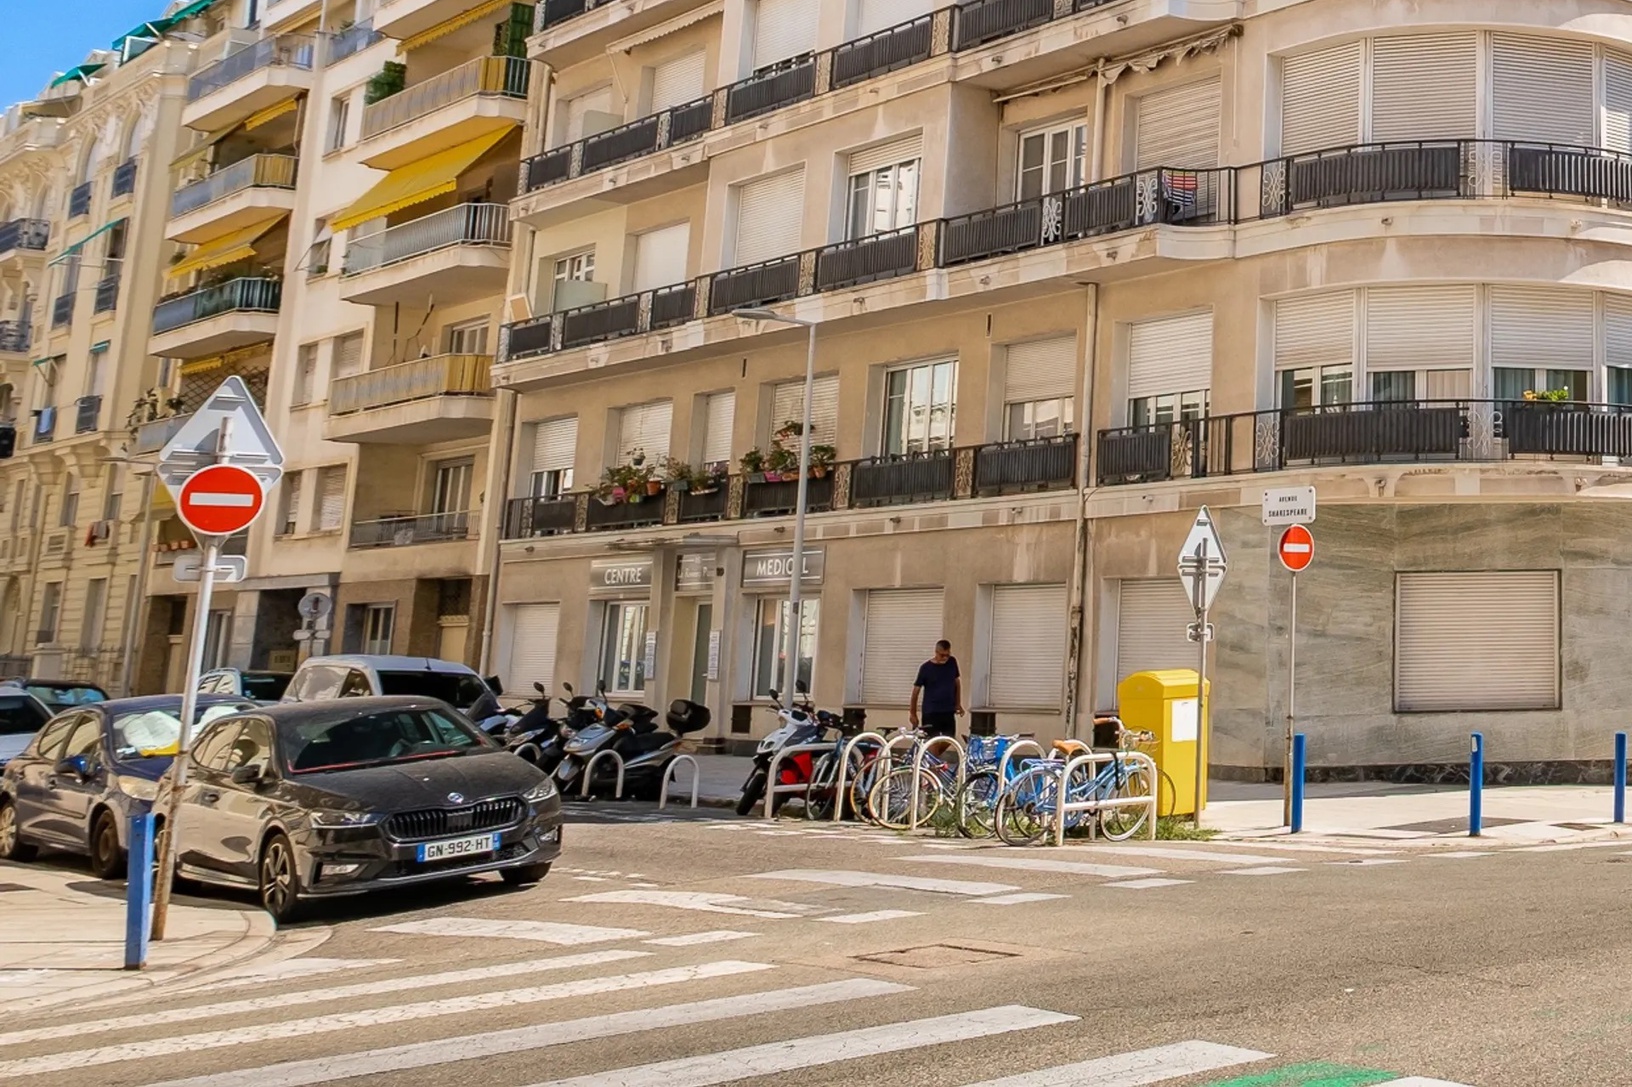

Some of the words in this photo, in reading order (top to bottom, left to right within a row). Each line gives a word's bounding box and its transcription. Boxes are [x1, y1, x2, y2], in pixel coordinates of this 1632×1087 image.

[1268, 508, 1307, 517] SHAKESPEARE
[604, 567, 642, 584] CENTRE
[427, 837, 491, 858] GN-992-HT
